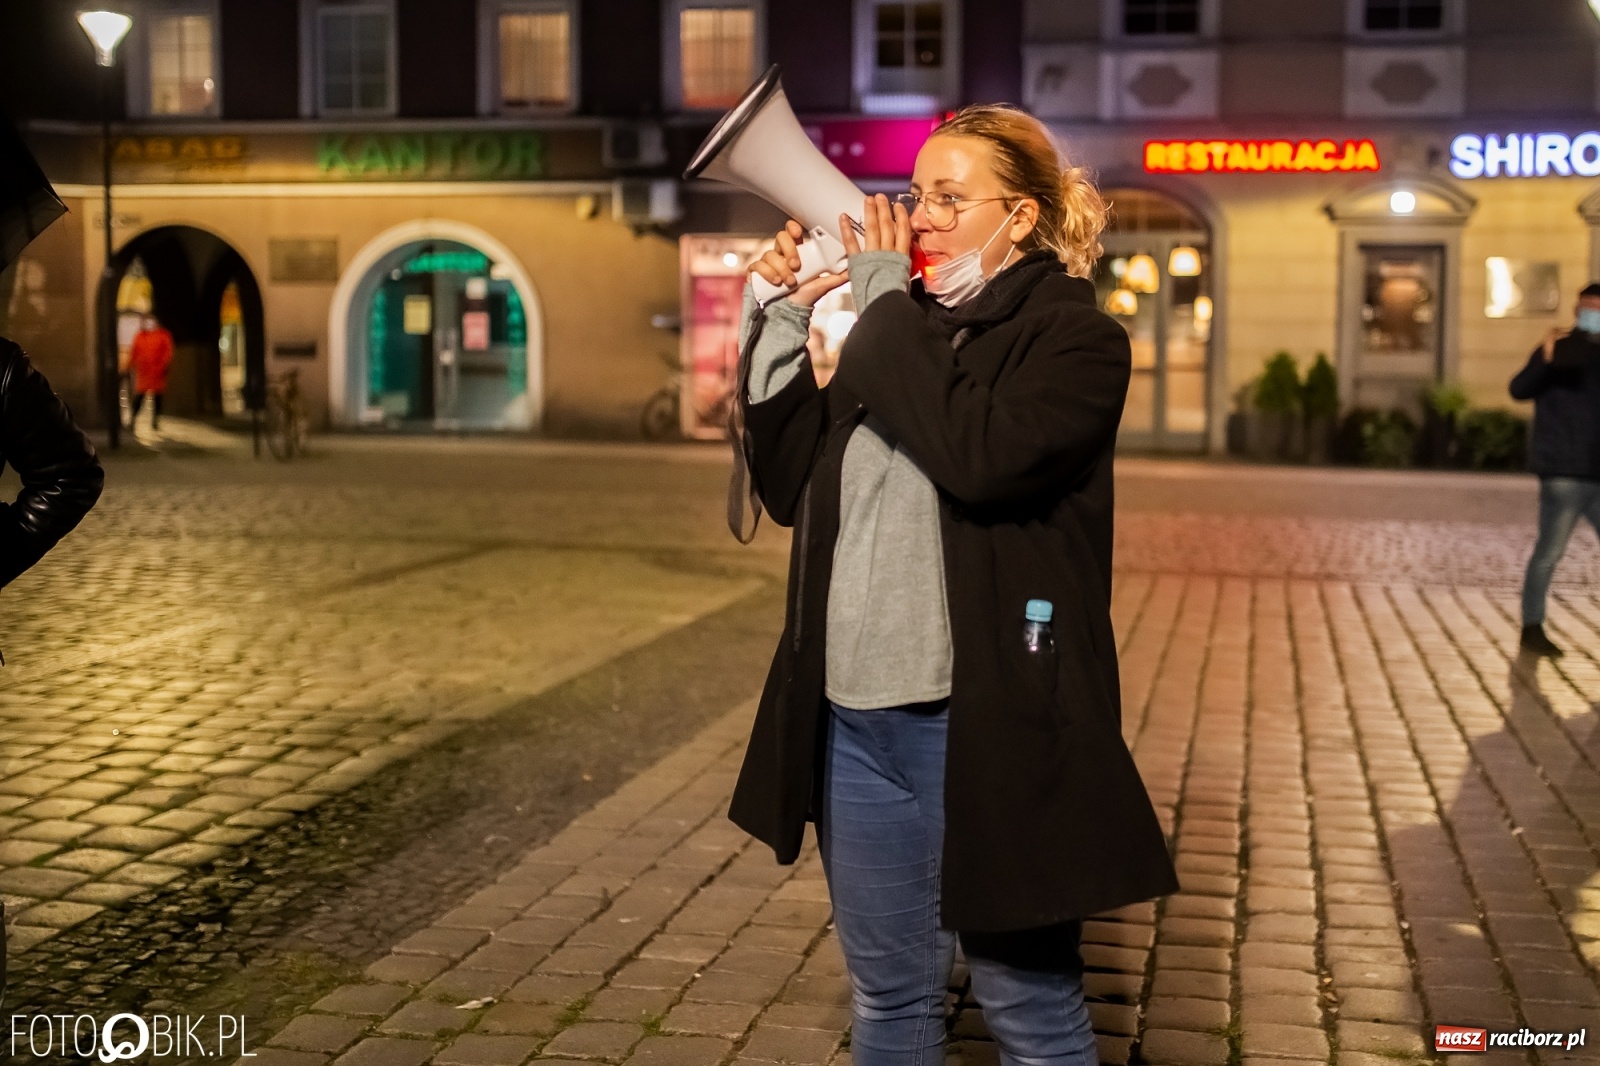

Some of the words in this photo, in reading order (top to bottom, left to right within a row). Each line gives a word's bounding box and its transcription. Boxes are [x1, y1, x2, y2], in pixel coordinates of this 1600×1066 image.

[317, 133, 542, 177] KANTOR
[1144, 139, 1381, 173] RESTAURACJA
[1449, 131, 1600, 179] SHIRO
